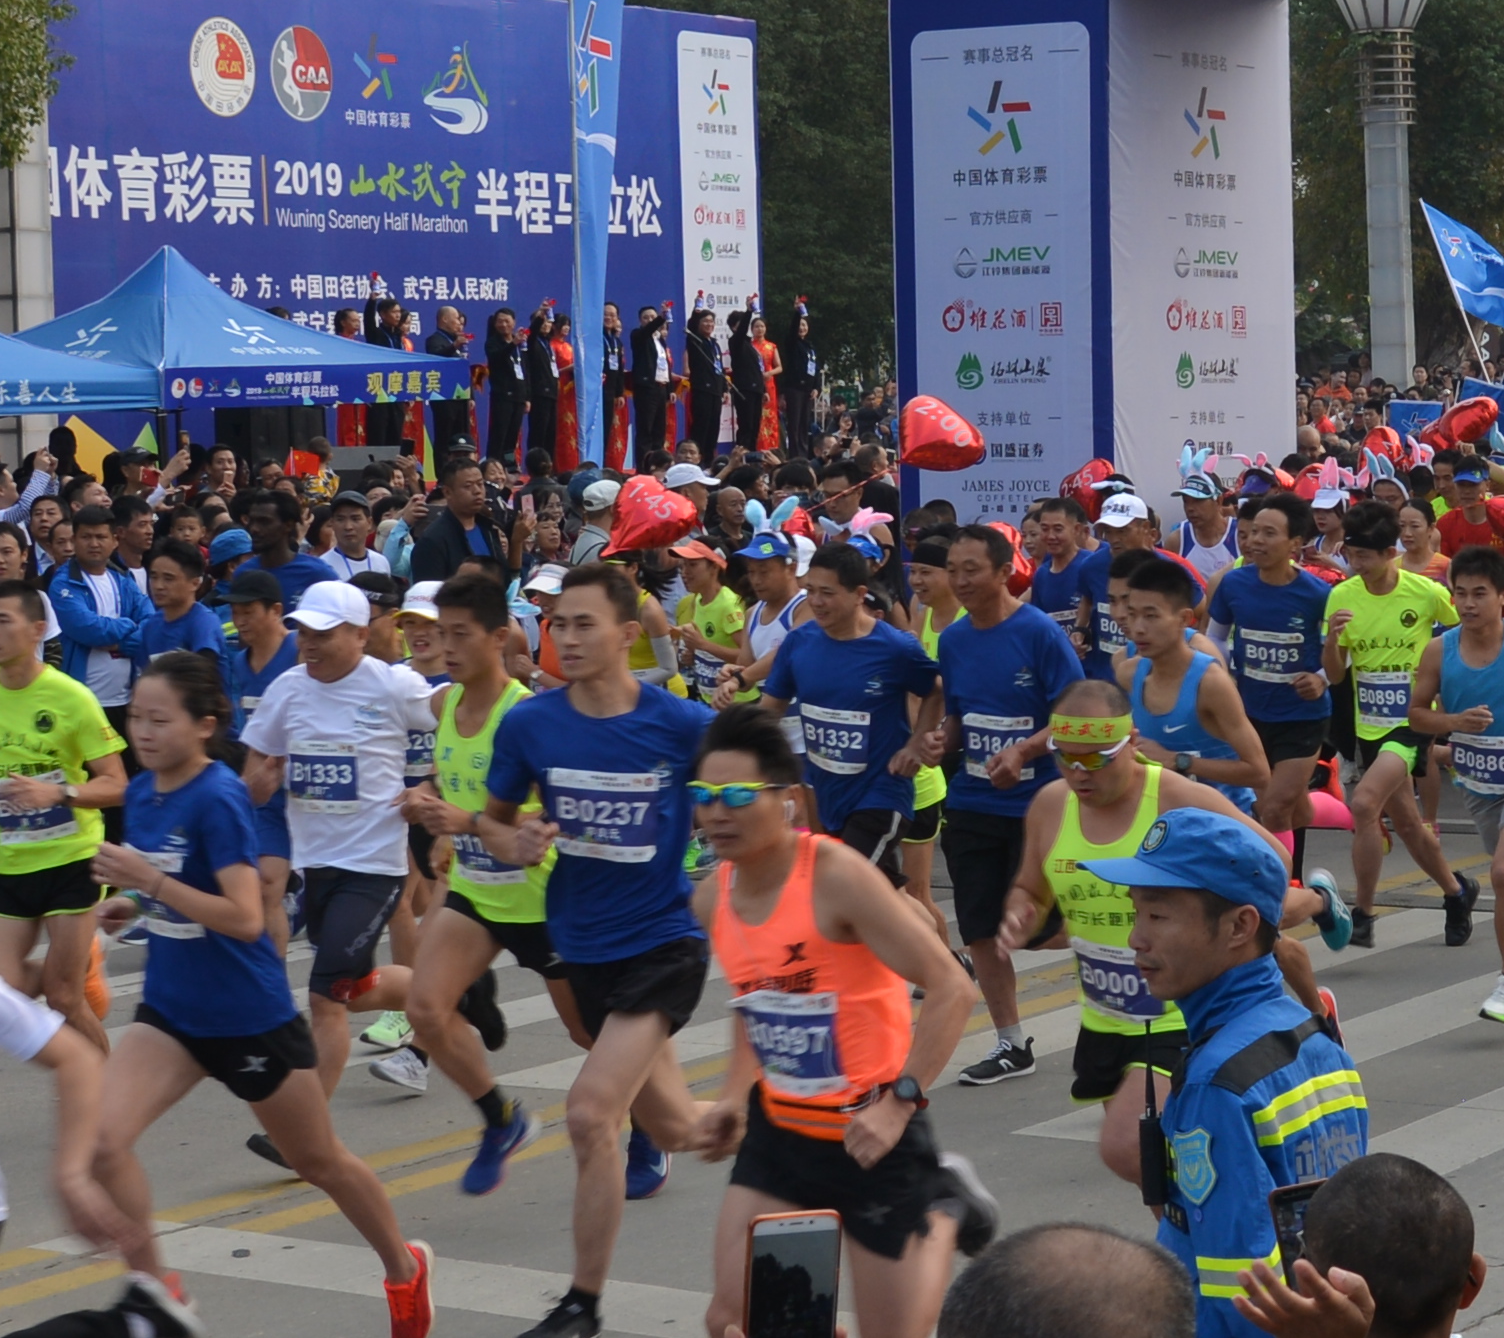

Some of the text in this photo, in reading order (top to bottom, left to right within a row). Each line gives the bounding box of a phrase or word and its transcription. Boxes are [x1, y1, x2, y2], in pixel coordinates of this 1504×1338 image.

[962, 44, 1034, 66] 赛事总冠名
[295, 64, 330, 85] CAA
[344, 107, 412, 129] 中国体育彩票
[274, 159, 343, 197] 2019
[349, 160, 467, 210] 山水武宁
[952, 165, 1048, 188] 中国体育彩票
[1173, 169, 1237, 192] 中国体育彩票
[275, 207, 469, 235] Wuning Scenery Half Marathon
[969, 208, 1033, 227] 官方供应商
[982, 245, 1052, 262] JMEV
[1193, 249, 1239, 265] JMEV
[265, 370, 323, 385] 中国体育彩票
[366, 369, 442, 395] 观摩嘉宾
[914, 400, 974, 448] 2:00
[976, 410, 1033, 427] 支持单位
[1189, 410, 1226, 426] 支持单位
[990, 442, 1044, 459] 国盛证券
[961, 479, 1052, 493] JAMES JOYCE
[1061, 467, 1095, 499] 2:45
[628, 482, 678, 520] 1:45
[1245, 643, 1300, 663] B0193
[1358, 686, 1407, 706] B0896
[804, 722, 863, 750] B1332
[291, 762, 353, 784] B1333
[554, 795, 651, 826] B0237
